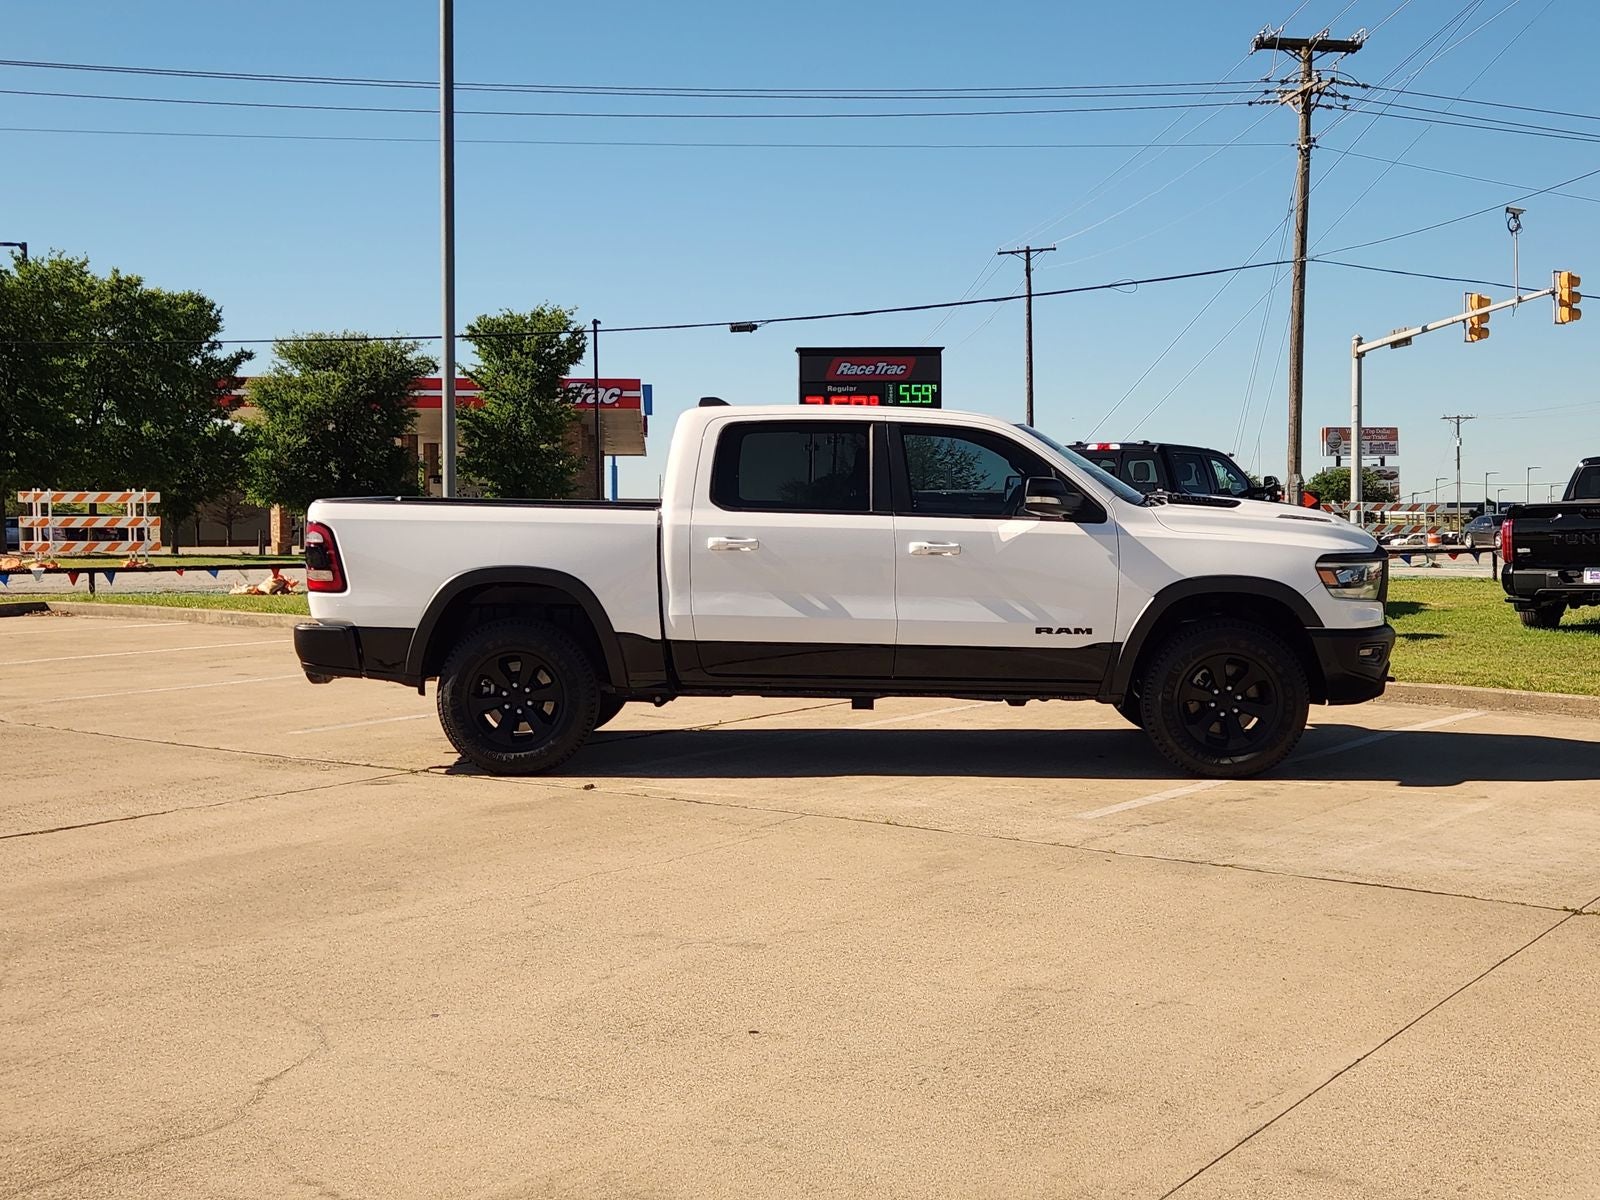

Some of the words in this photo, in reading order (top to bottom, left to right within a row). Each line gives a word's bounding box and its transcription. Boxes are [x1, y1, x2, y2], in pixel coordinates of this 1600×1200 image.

[836, 362, 907, 376] RaceTrac
[1548, 533, 1600, 545] TUN
[1034, 627, 1093, 635] RAM
